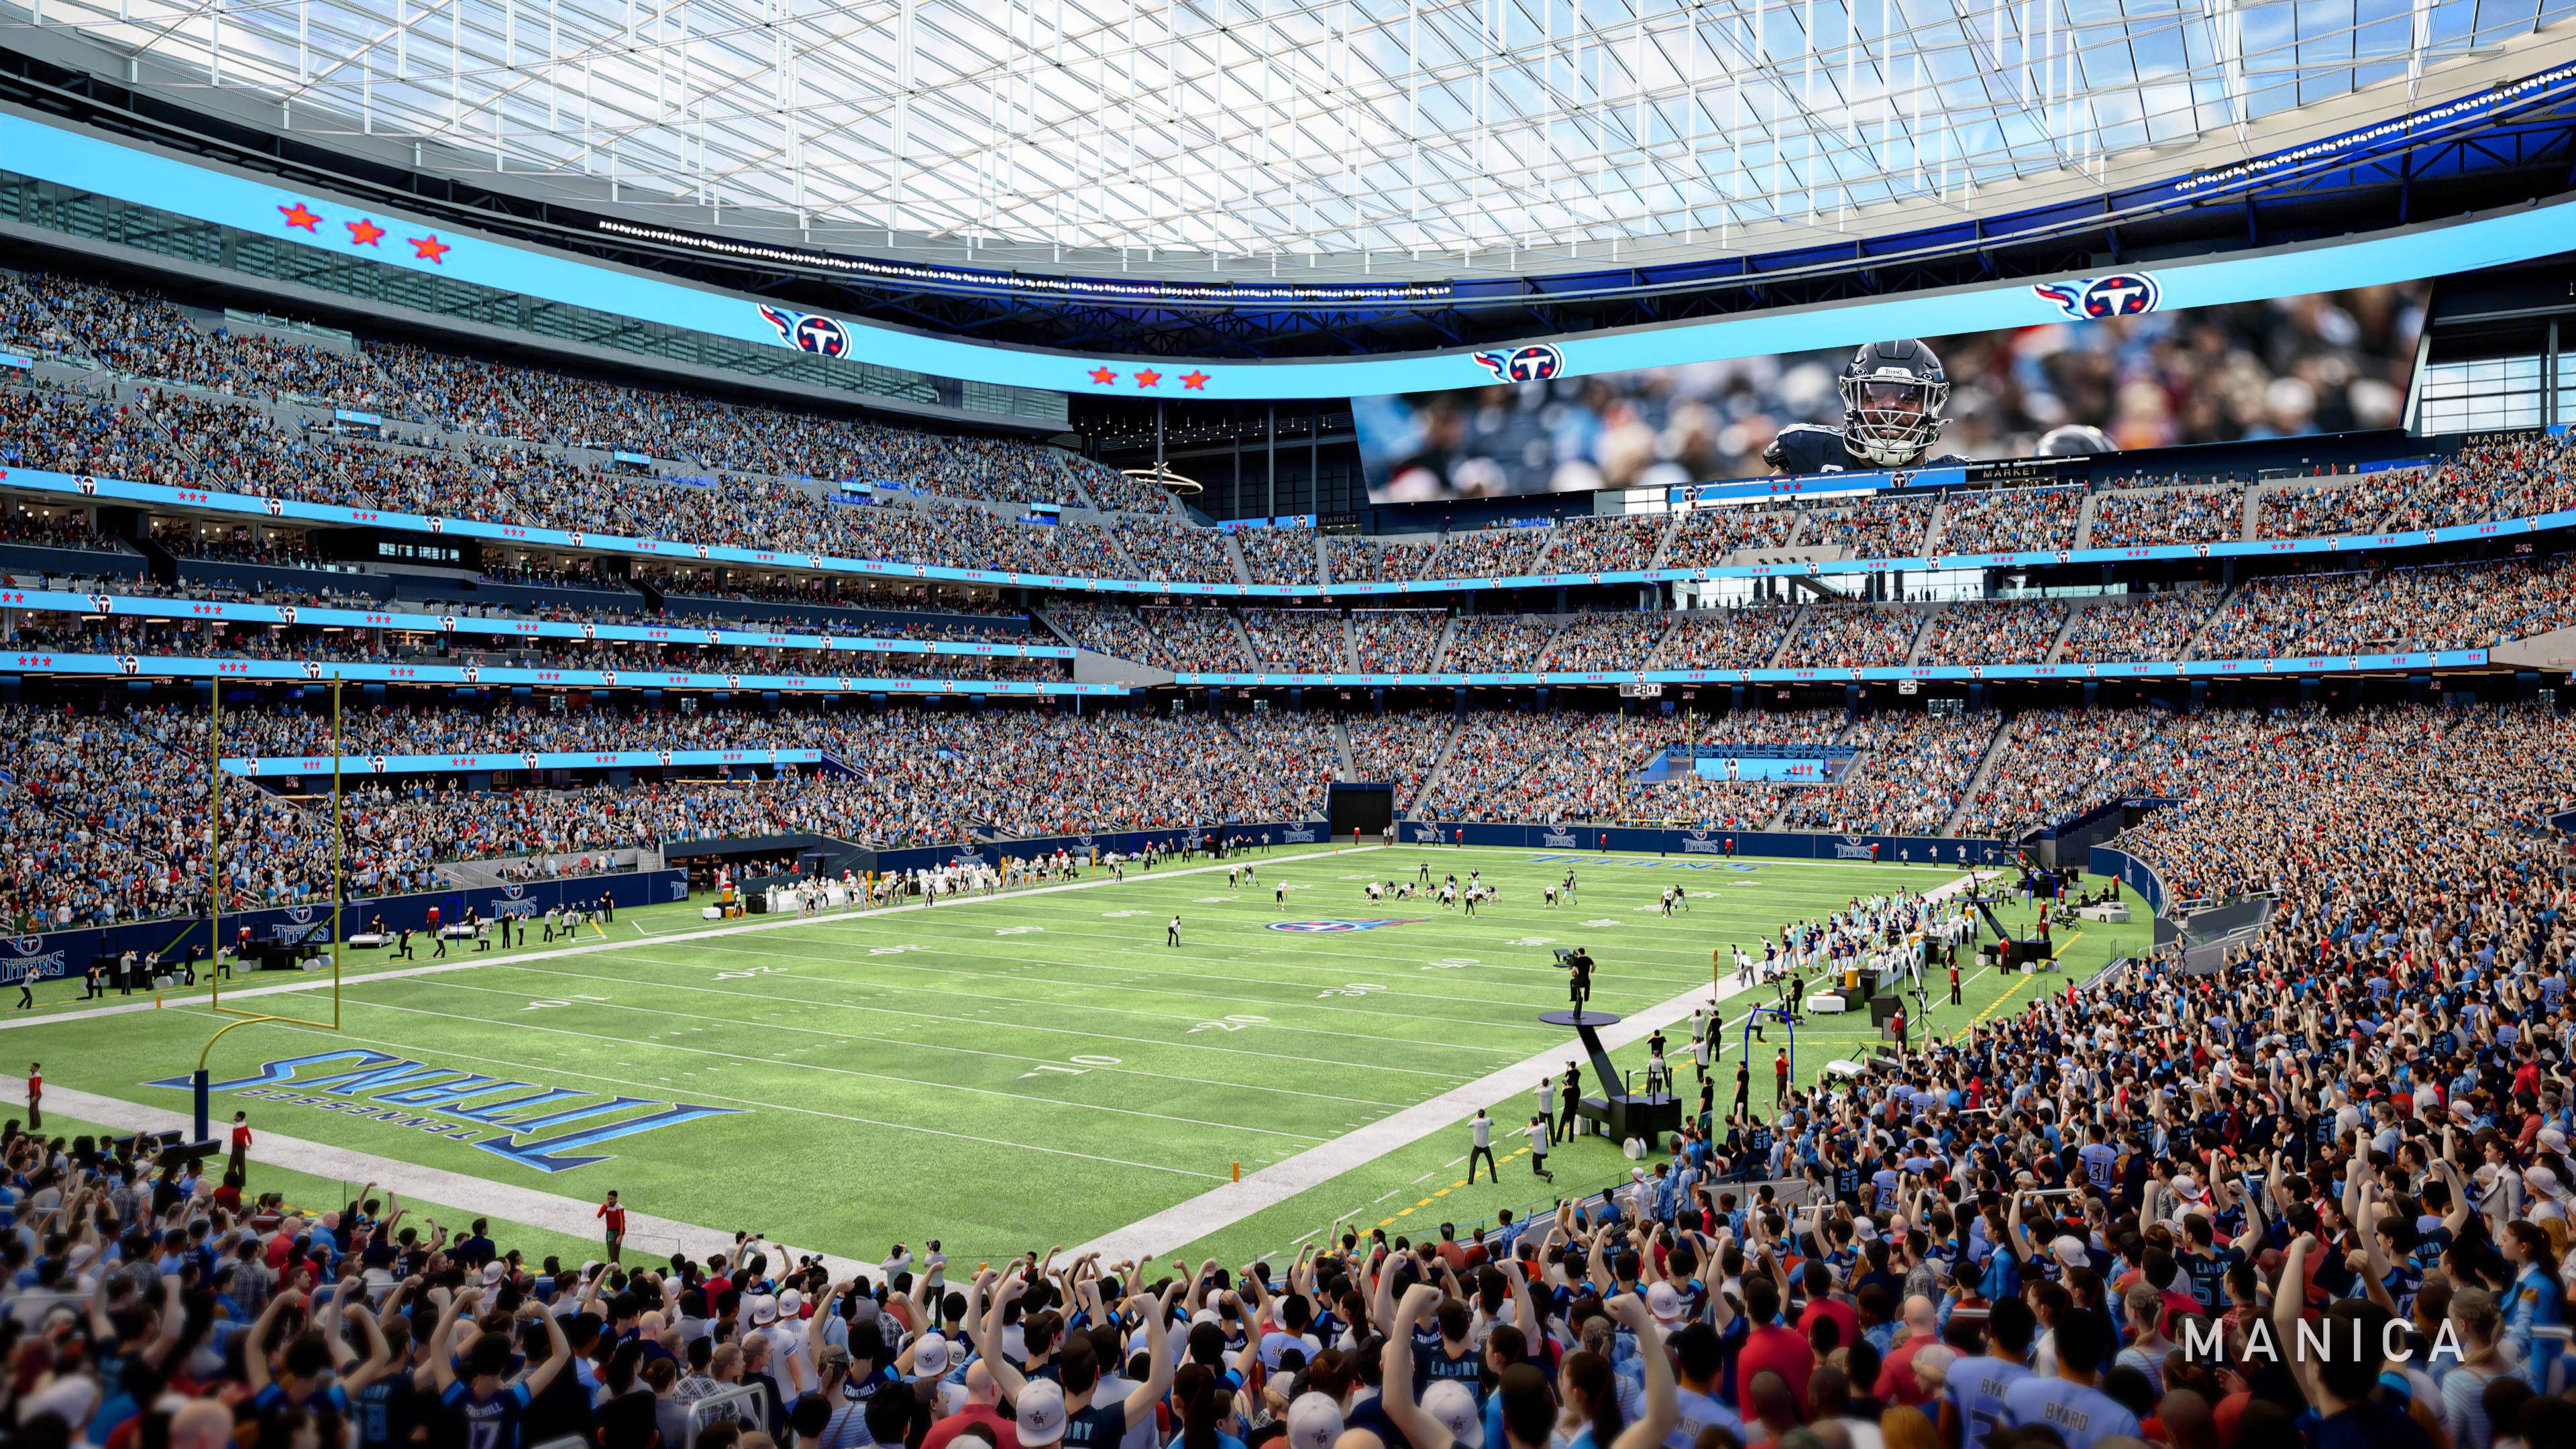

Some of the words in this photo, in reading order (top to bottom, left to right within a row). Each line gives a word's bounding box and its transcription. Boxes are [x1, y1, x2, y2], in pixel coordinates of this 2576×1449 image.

[2467, 431, 2538, 445] MARKET
[1983, 468, 2038, 478] MARKET
[1634, 684, 1660, 695] 2:00
[1900, 681, 1915, 692] 25
[1668, 744, 1778, 757] NASHVILLE
[1784, 745, 1856, 758] STAGE
[1283, 829, 1315, 843] TITANS
[1543, 833, 1576, 848] TITANS
[1682, 837, 1717, 853] TITANS
[1835, 843, 1873, 859] TITANS
[492, 896, 537, 920] TITANS
[717, 966, 788, 978] 20
[1322, 983, 1387, 996] 30
[529, 994, 612, 1008] 10
[1196, 1014, 1271, 1032] 20
[1034, 1055, 1122, 1075] 10
[138, 1048, 756, 1173] TITANS
[233, 1089, 482, 1140] TENNESSEE
[2317, 1123, 2335, 1142] 58
[1754, 1136, 1769, 1149] 58
[2089, 1162, 2108, 1182] 31
[1840, 1175, 1858, 1191] 58
[1431, 1362, 1479, 1377] LANDRY
[1980, 1378, 2008, 1401] BYA
[2045, 1402, 2089, 1433] BYARD
[467, 1421, 502, 1448] 17
[1678, 1415, 1701, 1438] ARD
